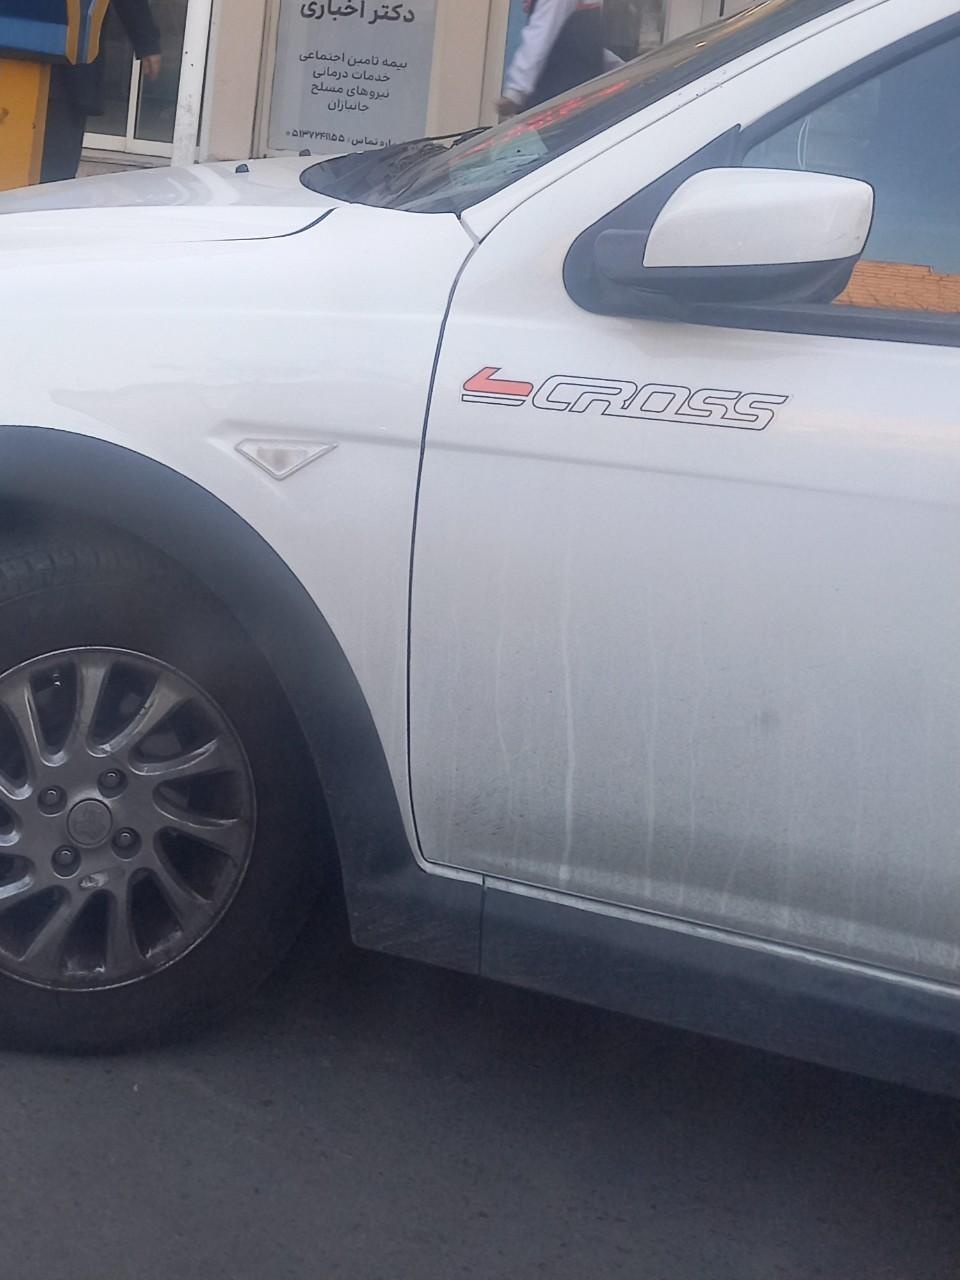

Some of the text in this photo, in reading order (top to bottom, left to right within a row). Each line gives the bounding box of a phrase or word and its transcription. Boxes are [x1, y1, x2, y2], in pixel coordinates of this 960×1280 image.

[368, 3, 416, 25] دکتر
[298, 49, 408, 71] بیمه تامین اجتماعی
[312, 66, 391, 83] خدمات درمانی
[310, 81, 390, 100] نیروهای مسلح
[327, 98, 369, 112] جانبازان
[531, 373, 791, 431] CROSS
